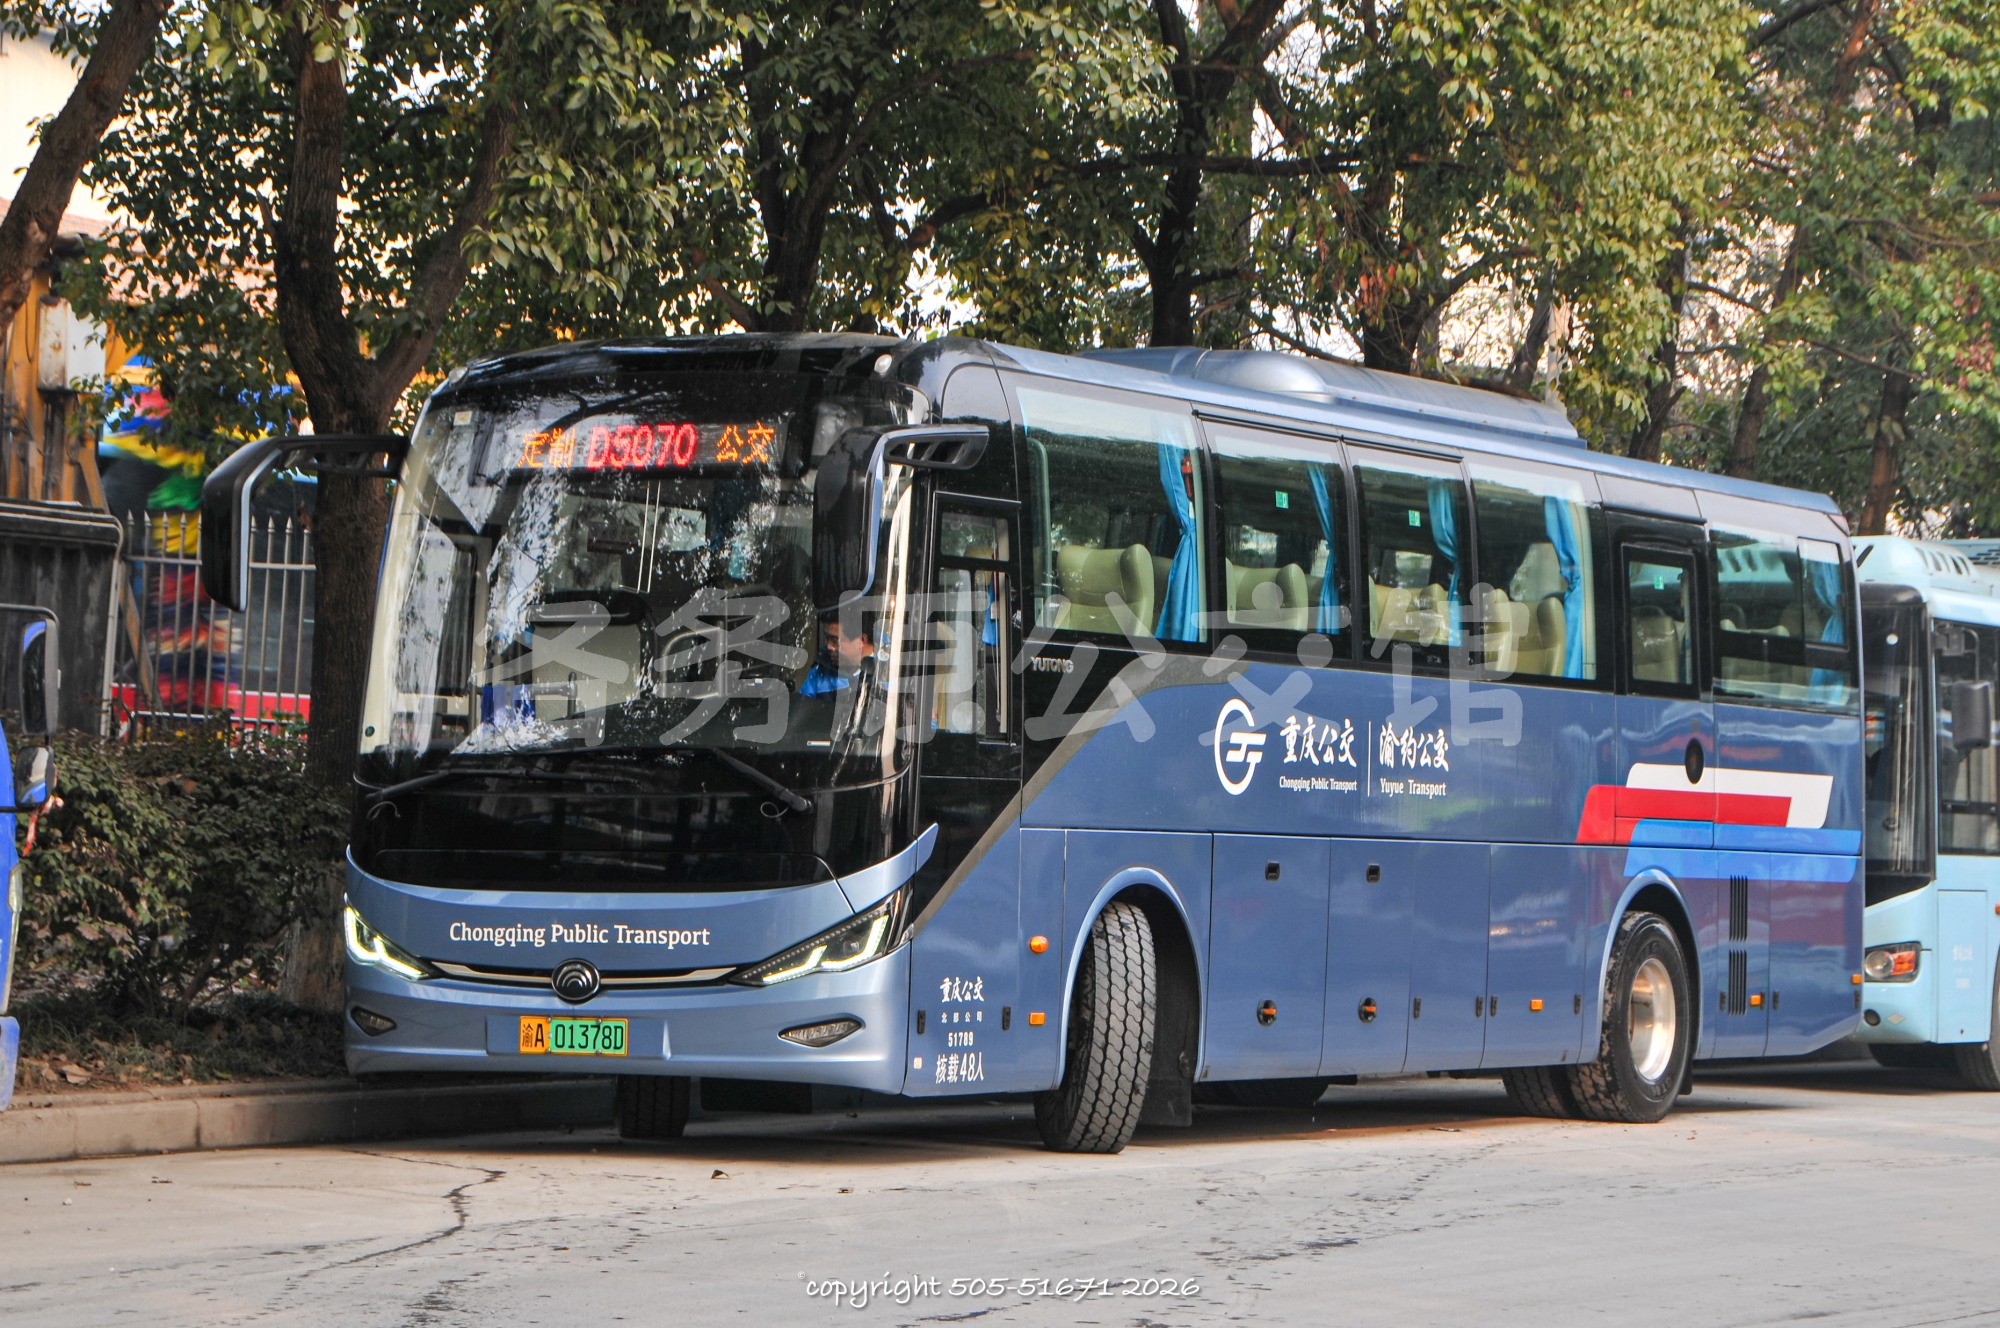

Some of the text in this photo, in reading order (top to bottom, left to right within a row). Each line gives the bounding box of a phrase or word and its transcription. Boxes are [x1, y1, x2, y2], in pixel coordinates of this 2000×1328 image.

[517, 420, 775, 470] 定制 D5070 公交
[1030, 656, 1075, 674] YUTONG
[1280, 715, 1357, 767] 重庆公交
[1379, 722, 1449, 771] 渝约公交
[1279, 776, 1357, 794] Chongqing Public Transport
[1380, 778, 1446, 799] Yuyue Transport
[450, 922, 710, 950] Chongqing Public Transport
[940, 976, 984, 1002] 重庆公交
[948, 1031, 973, 1046] 51789
[935, 1052, 984, 1083] 核载48人
